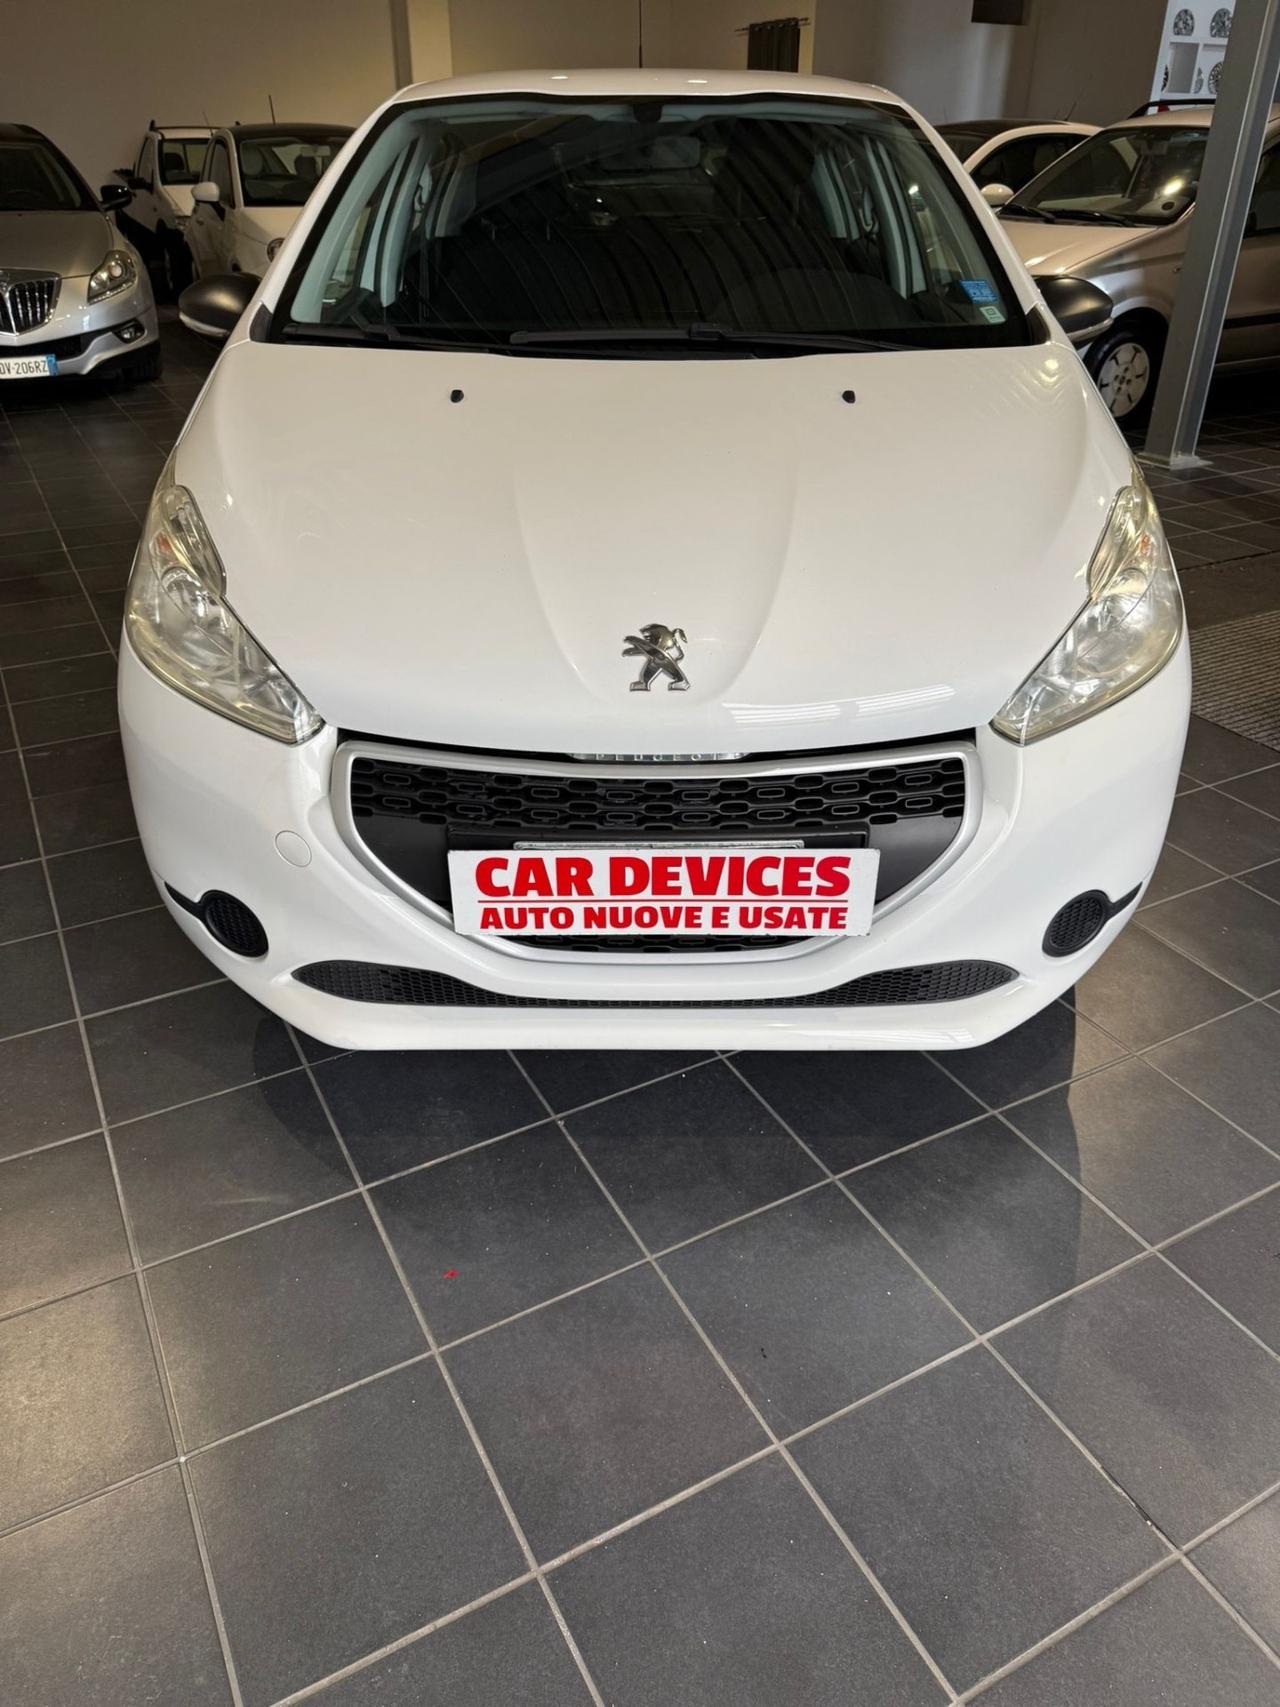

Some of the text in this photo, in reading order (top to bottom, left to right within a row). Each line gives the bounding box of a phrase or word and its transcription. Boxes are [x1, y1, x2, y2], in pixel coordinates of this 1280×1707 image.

[474, 855, 852, 898] CAR DEVICES
[480, 906, 848, 930] AUTO NUOVE E USATE
